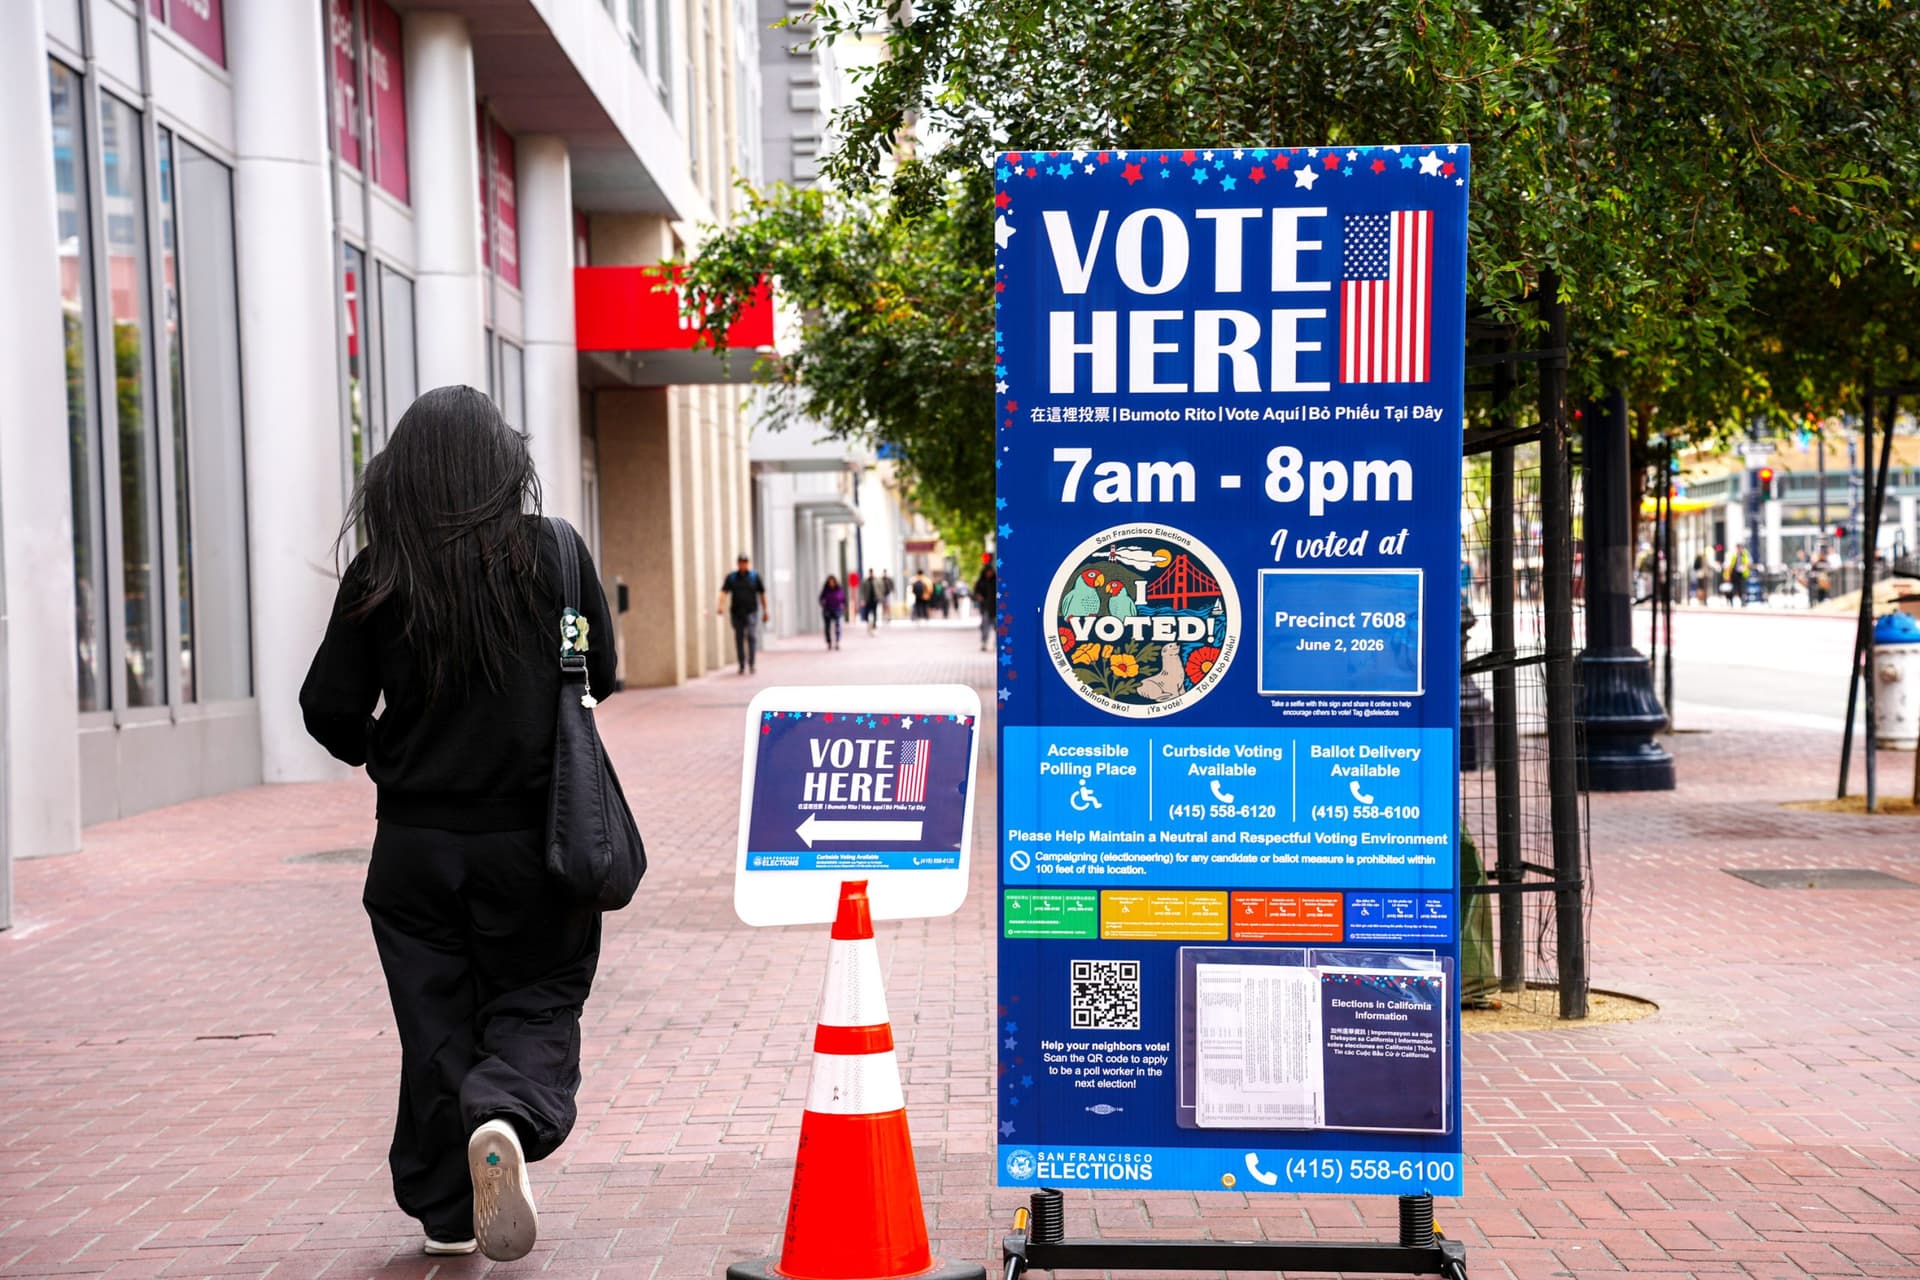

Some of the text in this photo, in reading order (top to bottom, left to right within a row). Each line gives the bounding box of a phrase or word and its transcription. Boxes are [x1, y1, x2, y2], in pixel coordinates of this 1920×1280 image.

[1042, 207, 1331, 295] VOTE
[1049, 308, 1331, 394] HERE
[1030, 407, 1110, 423] 在這裡投票
[1119, 407, 1217, 422] Bumoto Rito
[1225, 405, 1299, 424] Vote Aquí
[1309, 403, 1443, 424] Bỏ Phiếu Tại Đây
[1053, 445, 1413, 517] 7am - 8pm
[1096, 528, 1191, 546] San Francisco Elections
[1270, 528, 1410, 562] I voted at
[1135, 581, 1148, 605] I
[1275, 612, 1406, 628] Precinct 7608
[1069, 616, 1215, 643] VOTED!
[1296, 639, 1384, 653] June 2, 2026
[1080, 685, 1130, 712] Bumoto ako!
[810, 738, 895, 769] VOTE
[1048, 743, 1129, 757] Accessible
[1162, 744, 1282, 760] Curbside Voting
[1311, 745, 1421, 761] Ballot Delivery
[1040, 762, 1137, 778] Polling Place
[1188, 763, 1256, 776] Available
[1330, 764, 1400, 776] Available
[803, 772, 894, 802] HERE
[1169, 804, 1276, 821] (415) 558-6120
[1311, 805, 1420, 821] (415) 558-6100
[1008, 830, 1448, 847] Please Help Maintain a Neutral and Respectful Voting Environment
[762, 859, 799, 867] ELECTIONS
[1035, 852, 1436, 866] Campaigning (electioneering) for any candidate or ballot measure is prohibited within
[1035, 864, 1147, 875] 100 feet of this location.
[1332, 999, 1432, 1010] Elections in California
[1355, 1011, 1408, 1021] Information
[1041, 1040, 1170, 1052] Help your neighbors vote!
[1043, 1053, 1168, 1066] Scan the QR code to apply
[1049, 1066, 1058, 1075] to
[1060, 1066, 1073, 1075] be
[1083, 1066, 1100, 1077] poll
[1102, 1066, 1134, 1076] worker
[1136, 1066, 1145, 1076] in
[1147, 1067, 1163, 1076] the
[1075, 1079, 1136, 1088] next election!
[1038, 1152, 1152, 1163] SAN FRANCISCO
[1037, 1162, 1152, 1180] ELECTIONS
[1286, 1157, 1454, 1183] (415) 558-6100
